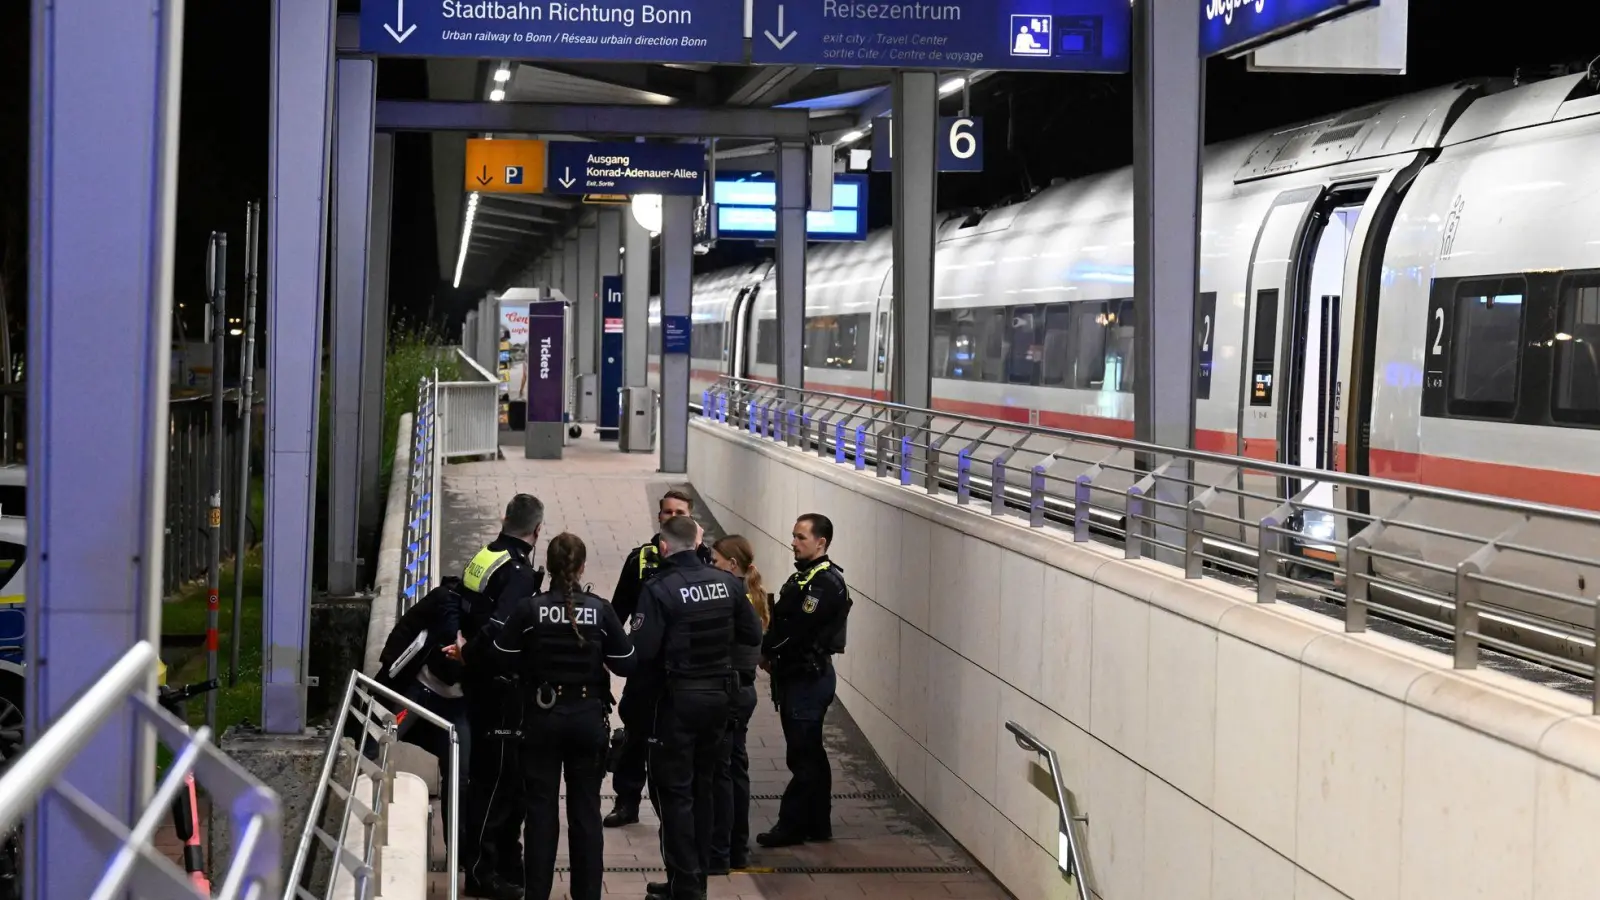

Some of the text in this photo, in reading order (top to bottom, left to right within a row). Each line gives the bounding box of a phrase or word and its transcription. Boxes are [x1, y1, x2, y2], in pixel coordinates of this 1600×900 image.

[442, 0, 692, 27] Stadtbahn Richtung Bonn
[823, 0, 961, 20] Reisezentrum
[442, 30, 707, 47] Urban railway to Bonn / Réseau urbain direction Bonn
[823, 33, 843, 43] exit
[846, 34, 866, 46] city
[876, 33, 908, 45] Travel
[912, 34, 949, 46] Center
[823, 48, 855, 58] sortie
[889, 49, 926, 60] Centre
[929, 50, 942, 60] de
[946, 51, 984, 63] voyage
[949, 118, 977, 159] 6
[587, 154, 630, 167] Ausgang
[506, 167, 518, 184] P
[586, 167, 698, 179] Konrad-Adenauer-Allee
[1202, 314, 1210, 352] 2
[1432, 307, 1445, 355] 2
[540, 337, 552, 379] Tickets
[680, 583, 730, 604] POLIZEI
[539, 606, 598, 625] POLZEI
